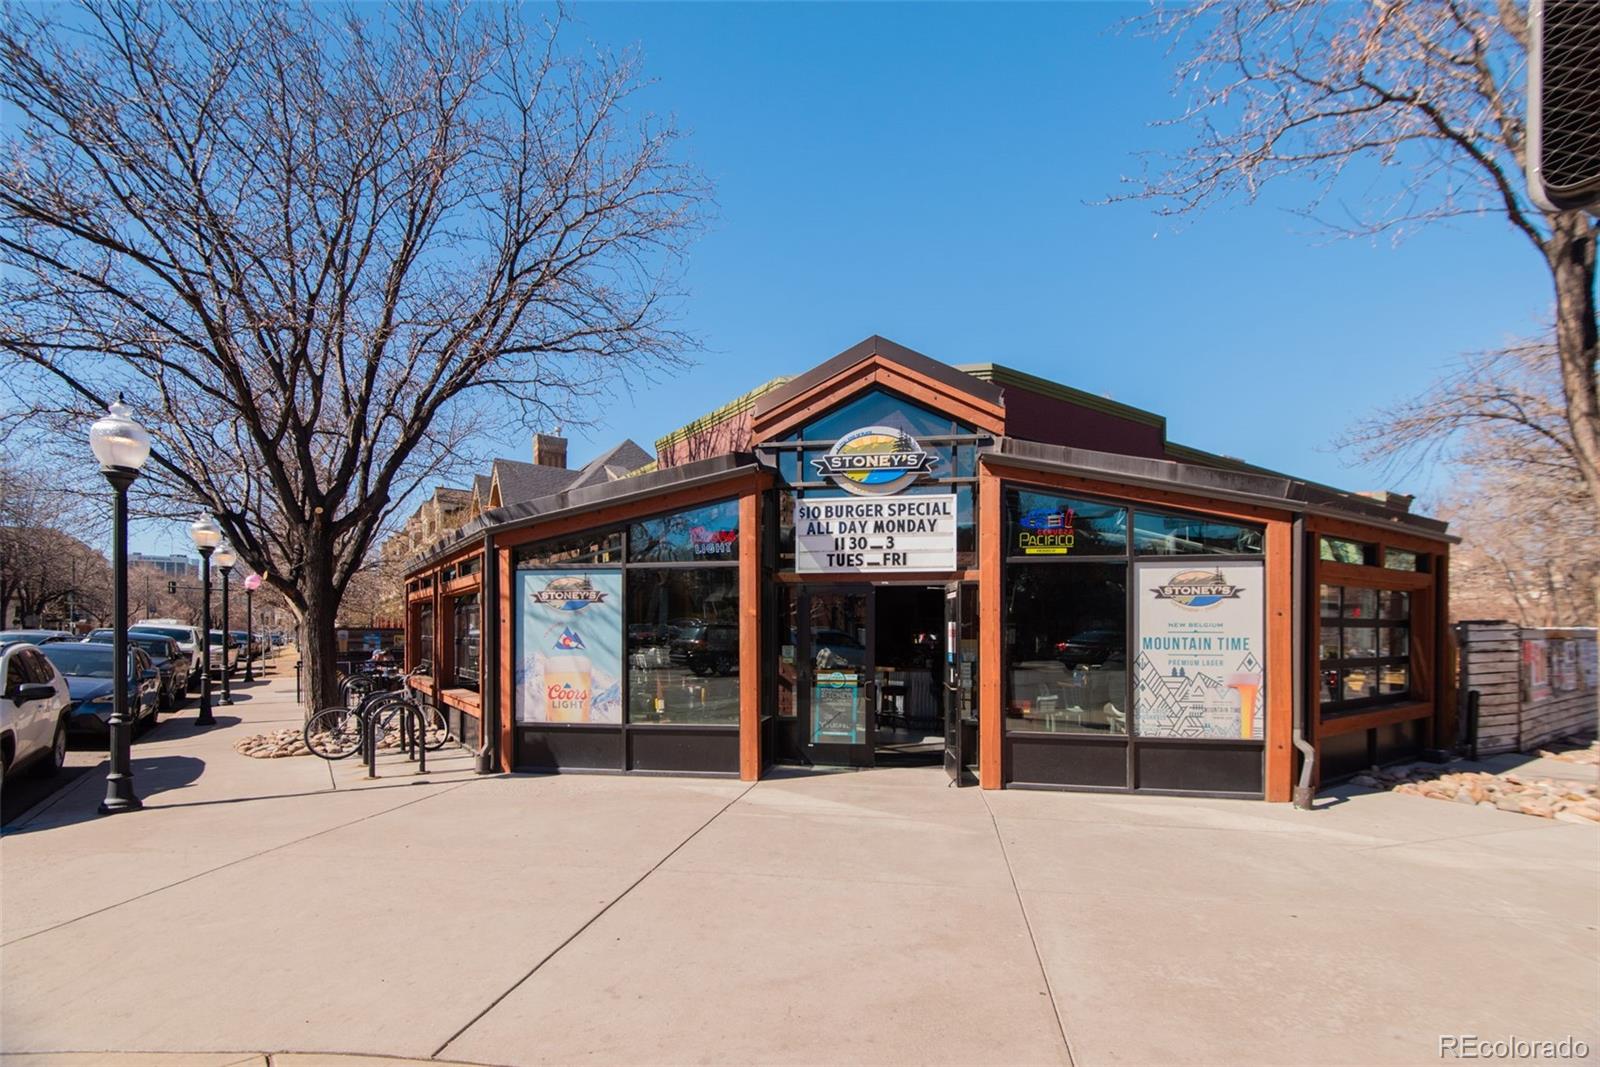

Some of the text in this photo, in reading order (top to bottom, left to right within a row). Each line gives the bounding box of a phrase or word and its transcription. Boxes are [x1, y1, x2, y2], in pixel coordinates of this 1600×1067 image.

[831, 454, 918, 468] STONEY'S
[800, 502, 951, 519] $10 BURGER SPECIAL
[807, 519, 937, 535] ALL DAY MONDAY
[541, 591, 597, 600] STONEY'S
[1163, 586, 1231, 595] STONEY'S
[1142, 637, 1250, 651] MOUNTAIN TIME
[547, 684, 588, 700] Coors
[552, 701, 584, 709] LIGHT
